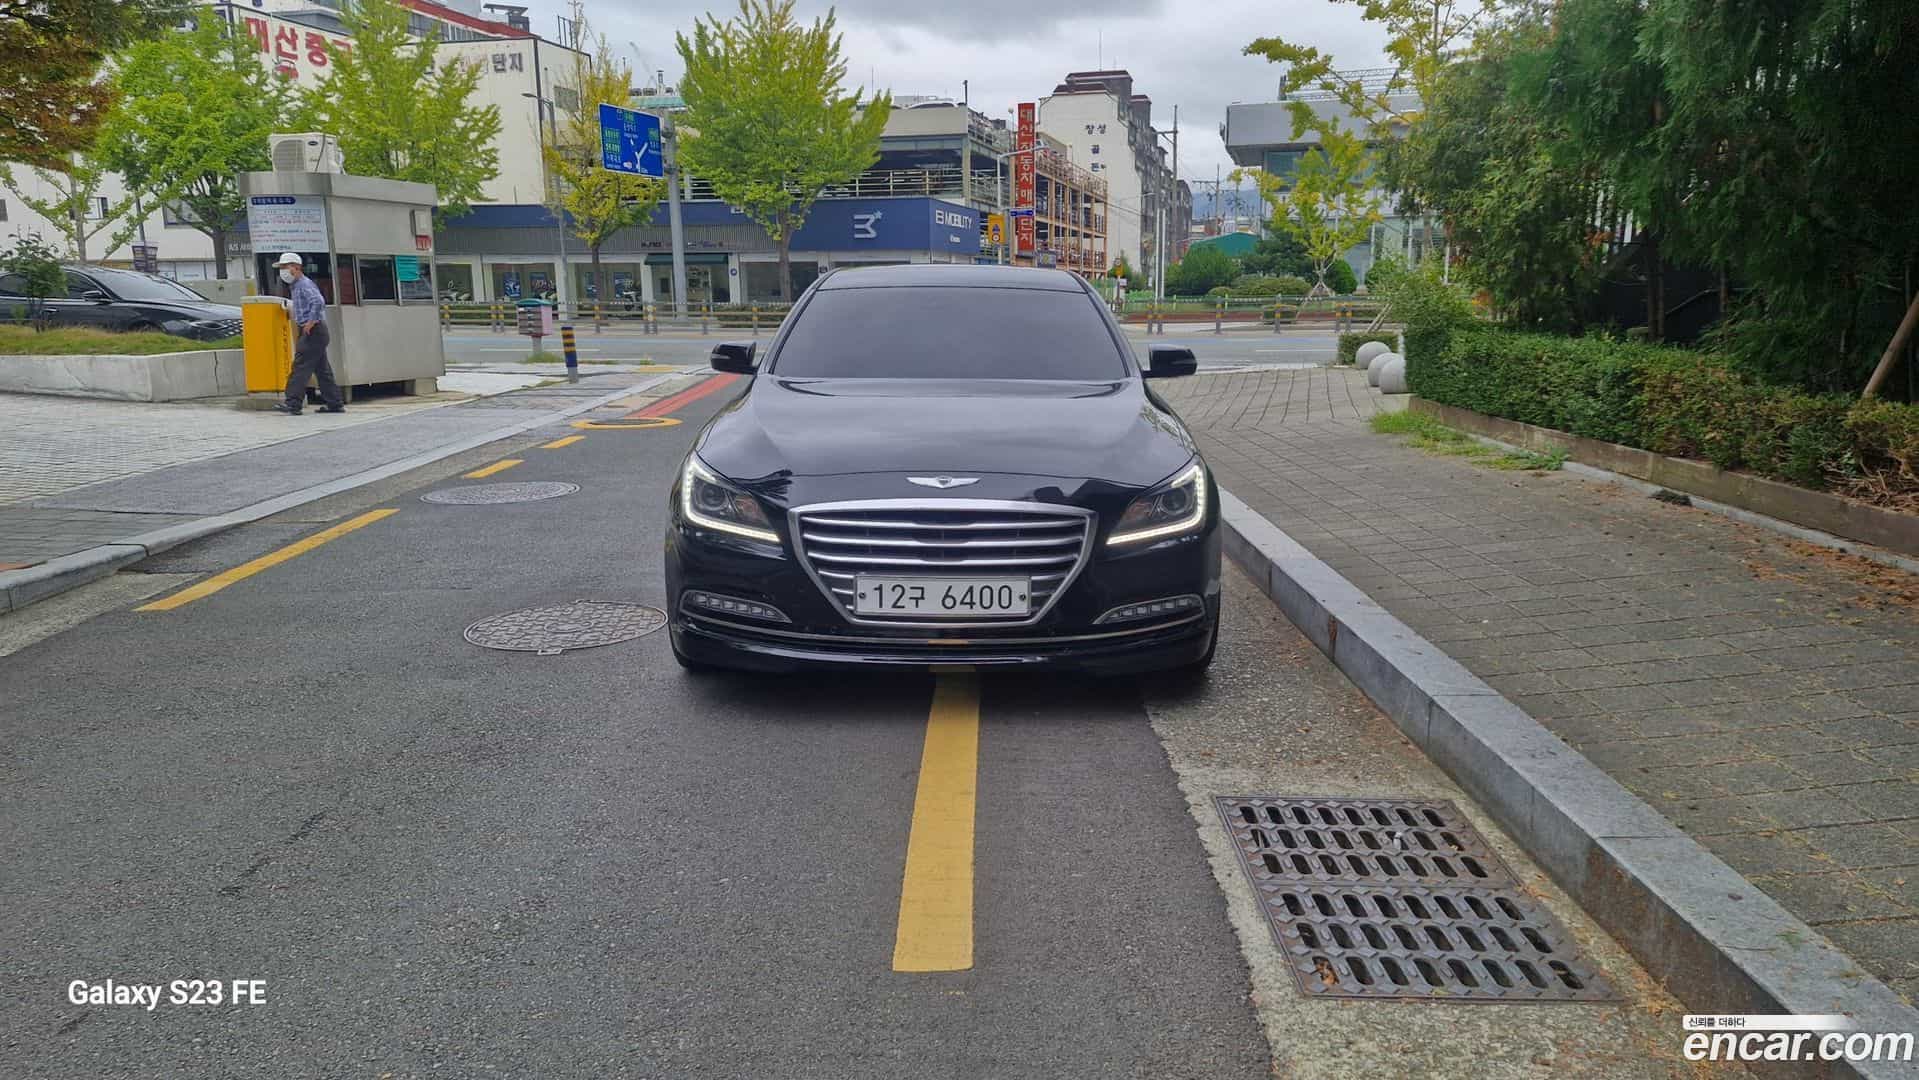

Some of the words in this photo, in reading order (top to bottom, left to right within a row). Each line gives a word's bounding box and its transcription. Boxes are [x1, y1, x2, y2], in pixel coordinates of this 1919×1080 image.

[935, 209, 944, 225] B
[944, 211, 972, 231] MOBILITY
[873, 583, 926, 609] 12구
[941, 584, 1013, 610] 6400
